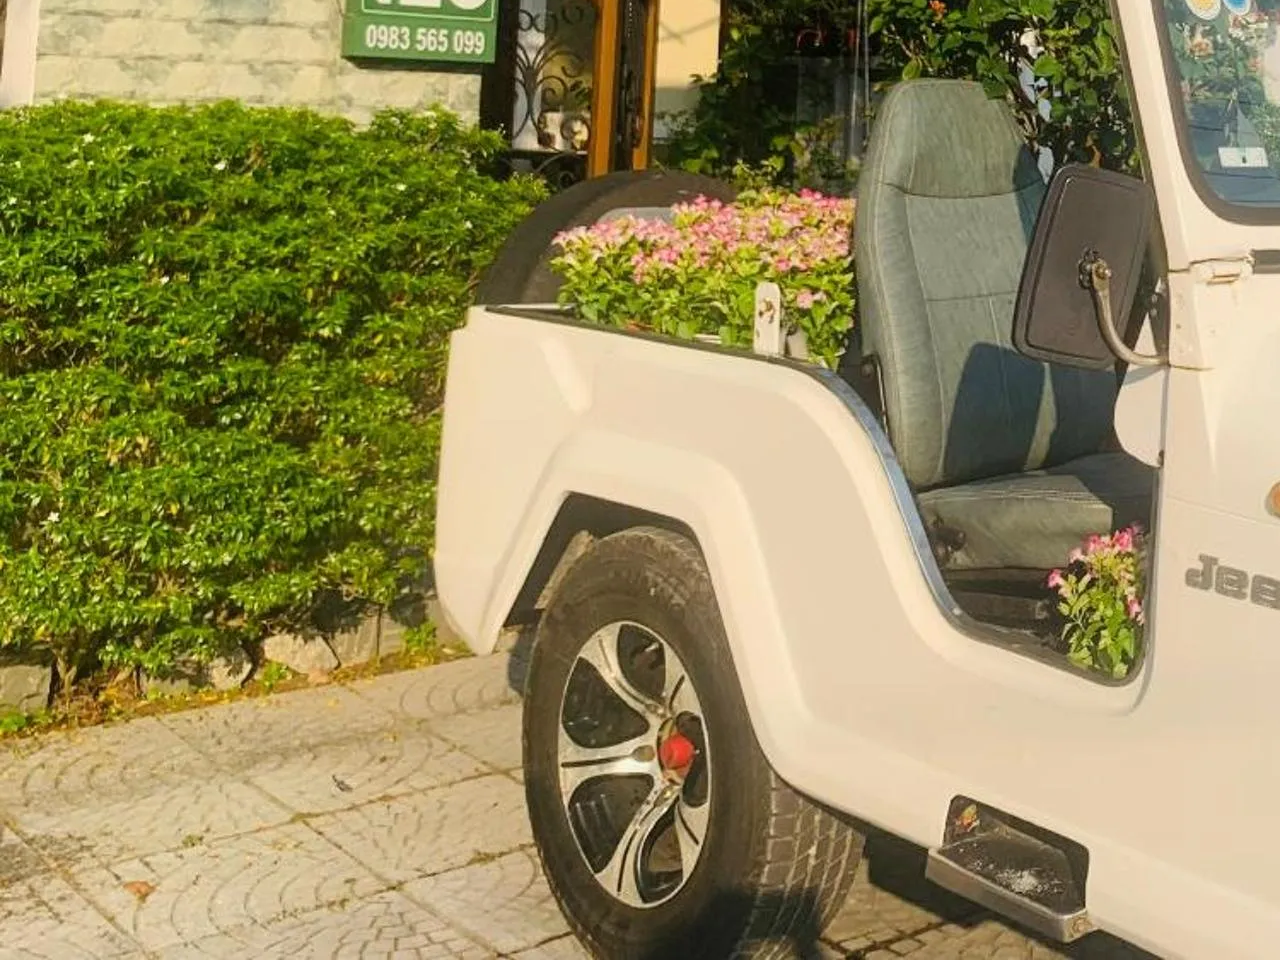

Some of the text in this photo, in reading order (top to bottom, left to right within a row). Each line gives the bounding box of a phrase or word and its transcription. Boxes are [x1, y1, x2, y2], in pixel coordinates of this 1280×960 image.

[365, 24, 486, 55] 0983 565 099
